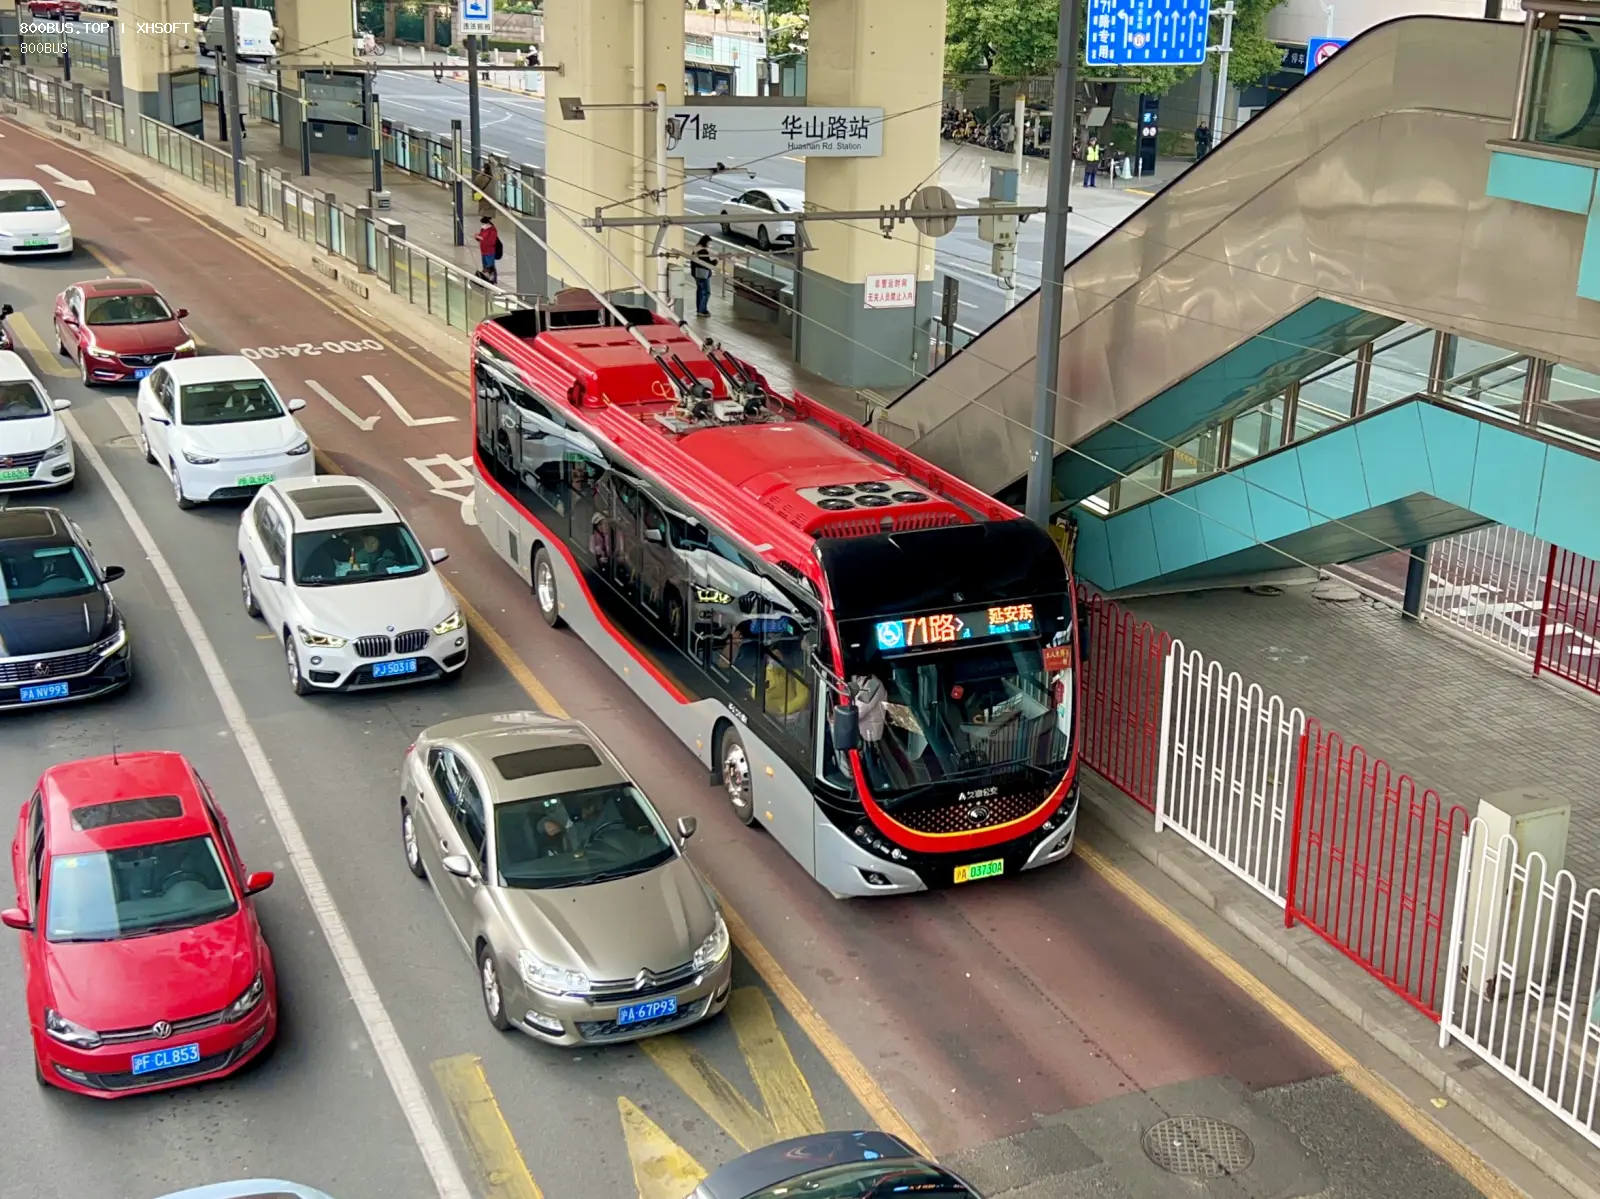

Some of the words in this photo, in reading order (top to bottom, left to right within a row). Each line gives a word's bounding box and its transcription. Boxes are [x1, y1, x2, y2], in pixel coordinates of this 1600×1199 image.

[674, 113, 718, 141] 71路
[781, 115, 871, 140] 华山路站
[787, 142, 821, 151] Huashan
[822, 142, 833, 151] Rd
[836, 142, 862, 151] Station
[988, 604, 1034, 625] 延安东
[902, 613, 955, 646] 71路
